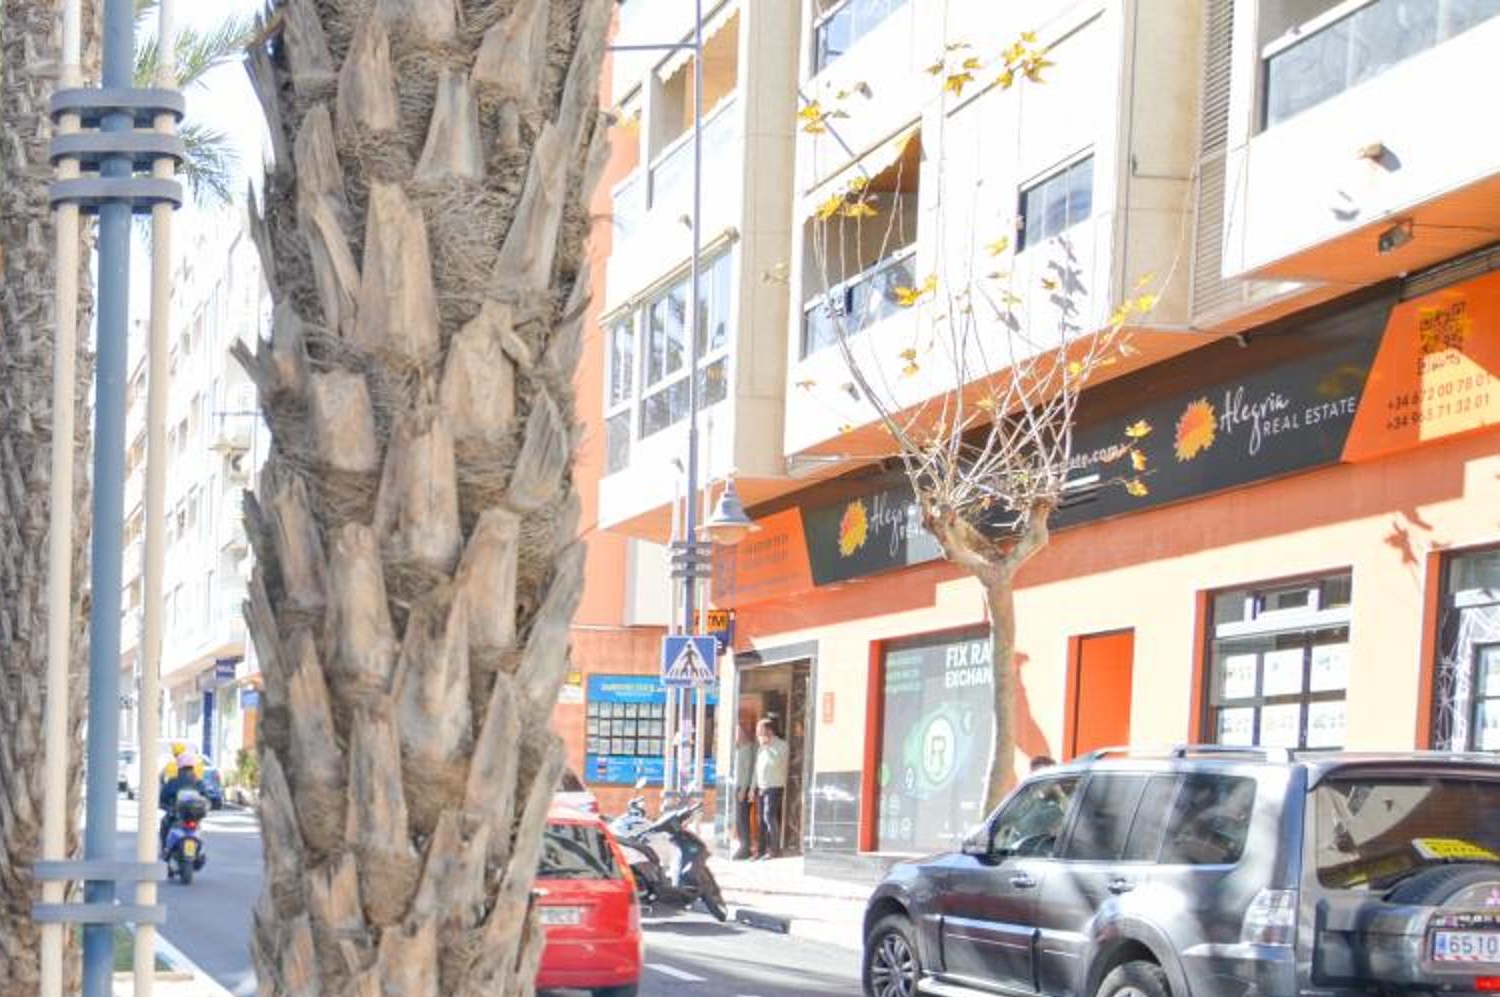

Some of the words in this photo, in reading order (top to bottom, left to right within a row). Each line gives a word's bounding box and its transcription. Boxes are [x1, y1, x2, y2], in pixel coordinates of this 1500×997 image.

[1220, 385, 1290, 456] Alegria
[1263, 413, 1299, 436] REAL
[1305, 397, 1357, 425] ESTATE
[946, 643, 968, 668] FIX
[970, 641, 991, 665] RA
[945, 667, 993, 689] EXCHAN
